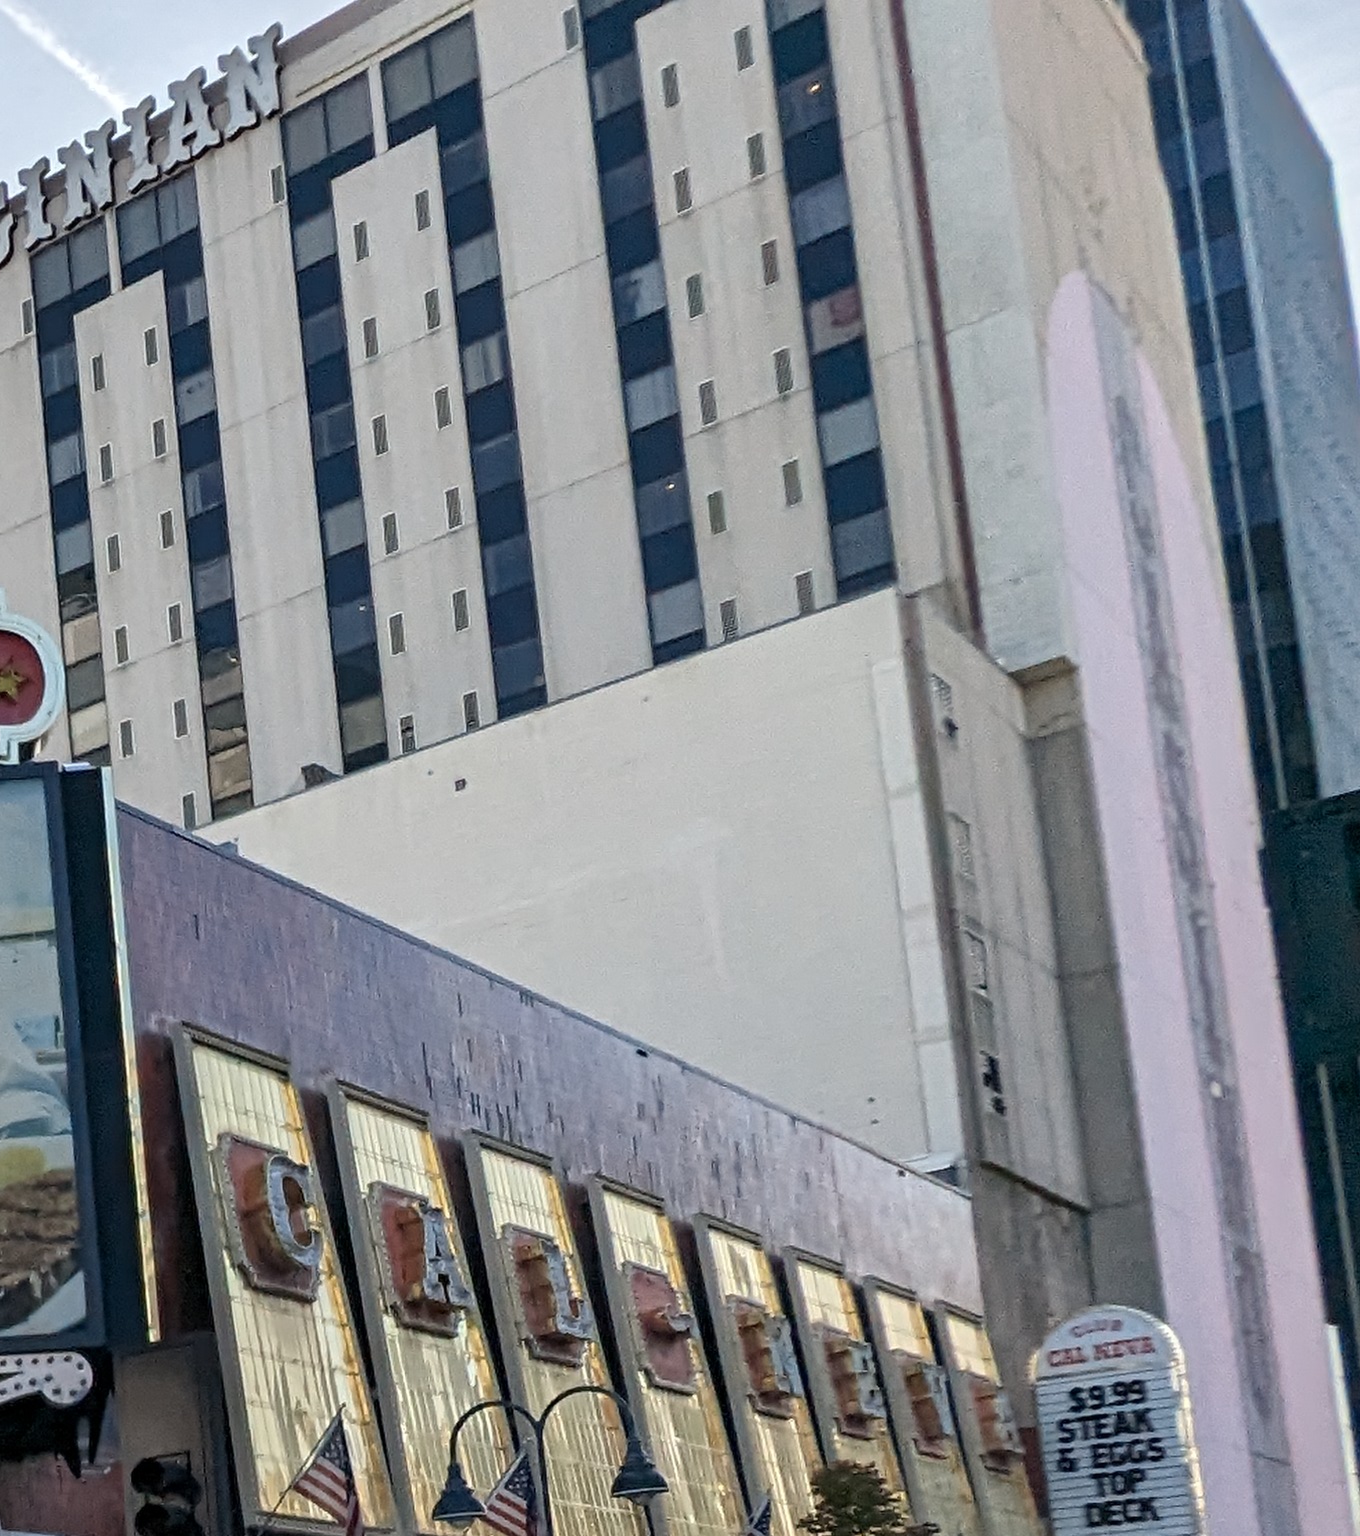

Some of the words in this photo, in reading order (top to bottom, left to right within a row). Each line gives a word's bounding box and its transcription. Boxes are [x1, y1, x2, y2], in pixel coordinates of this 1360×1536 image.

[1047, 1346, 1088, 1367] CAL
[1093, 1335, 1156, 1361] NEVA
[1058, 1408, 1155, 1444] STEAK
[1090, 1437, 1167, 1469] EGGS
[1089, 1469, 1147, 1498] TOP
[1085, 1497, 1161, 1528] DECK
